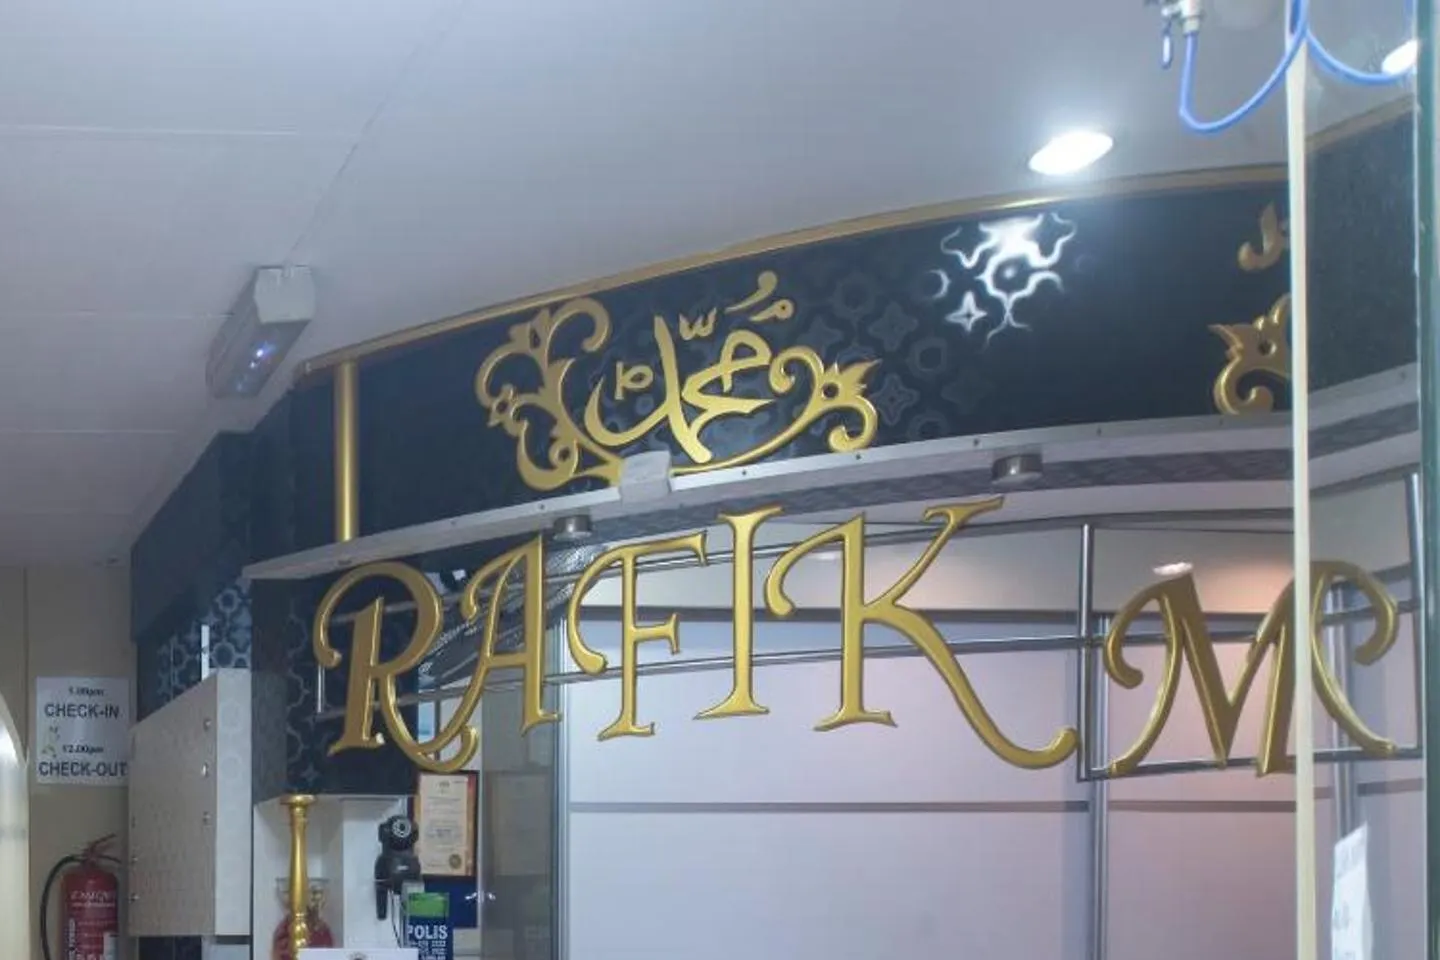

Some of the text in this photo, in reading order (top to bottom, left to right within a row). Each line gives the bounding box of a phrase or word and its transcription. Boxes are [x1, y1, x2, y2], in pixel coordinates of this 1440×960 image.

[312, 497, 1079, 772] RAFIK
[44, 703, 119, 719] CHECK-IN
[38, 761, 129, 777] CHECK-OUT
